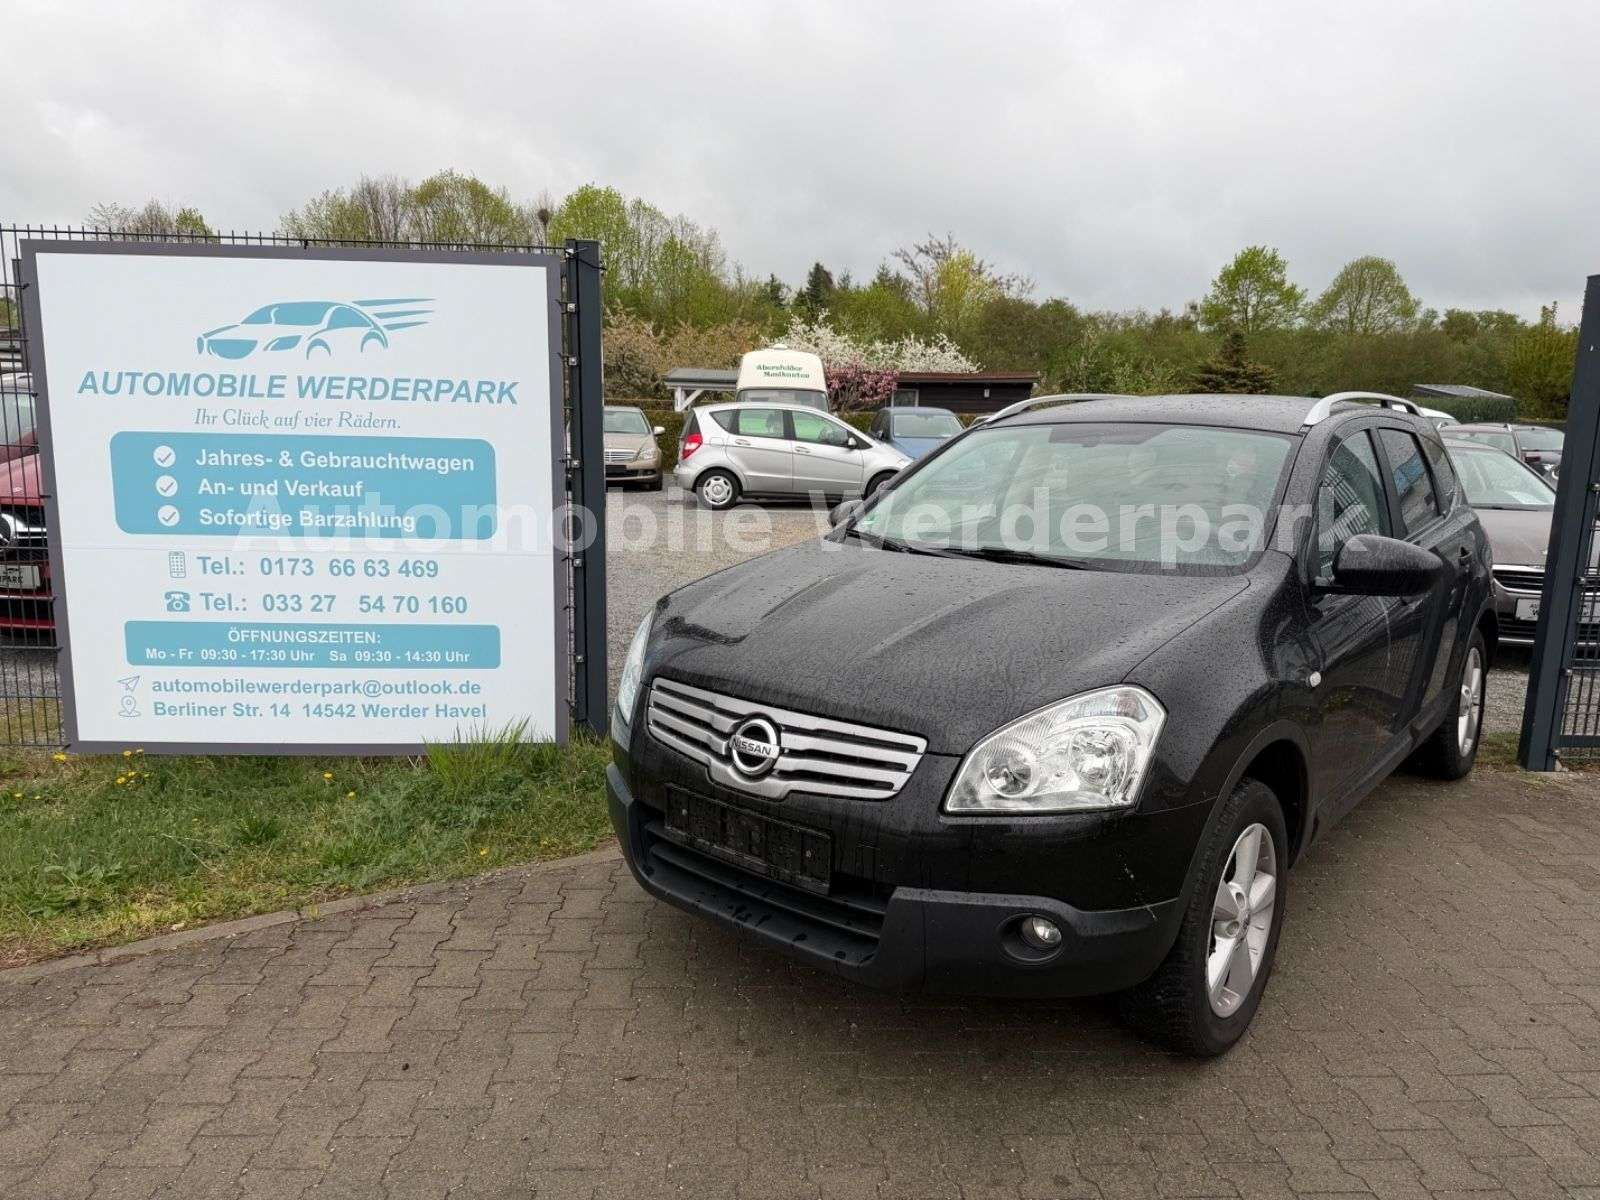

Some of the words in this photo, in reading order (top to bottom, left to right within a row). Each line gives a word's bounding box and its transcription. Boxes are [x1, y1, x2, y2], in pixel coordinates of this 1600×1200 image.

[78, 369, 286, 401] AUTOMOBILE
[296, 374, 520, 406] WERDERPARK
[194, 408, 217, 425] Ihr
[223, 408, 270, 429] Glück
[274, 410, 302, 430] auf
[304, 412, 333, 427] vier
[338, 411, 401, 429] Rädern.
[195, 449, 273, 467] Jahres-
[278, 450, 294, 467] &
[300, 451, 475, 475] Gebrauchtwagen
[198, 478, 234, 495] An-
[239, 479, 278, 496] und
[284, 480, 364, 498] Verkauf
[199, 508, 293, 531] Sofortige
[299, 510, 416, 533] Barzahlung
[197, 556, 246, 577] Tel.:
[260, 557, 315, 577] 0173
[328, 559, 357, 578] 66
[363, 559, 391, 578] 63
[398, 560, 440, 579] 469
[200, 593, 248, 613] Tel.:
[262, 594, 302, 613] 033
[309, 594, 337, 613] 27
[358, 595, 386, 614] 54
[392, 595, 420, 614] 70
[427, 596, 469, 615] 160
[228, 627, 382, 644] ÖFFNUNGSZEITEN:
[146, 648, 166, 659] Mo
[179, 648, 194, 660] Fr
[201, 649, 237, 660] 09:30
[251, 650, 286, 661] 17:30
[290, 650, 315, 661] Uhr
[329, 651, 347, 662] Sa
[355, 651, 392, 662] 09:30
[405, 651, 440, 662] 14:30
[445, 651, 471, 662] Uhr
[151, 679, 481, 698] automobilewerderpark@outlook.de
[154, 702, 227, 717] Berliner
[233, 703, 263, 717] Str.
[270, 703, 291, 718] 14
[303, 703, 356, 718] 14542
[361, 704, 429, 718] Werder
[435, 704, 486, 718] Havel
[732, 736, 772, 756] NISSAN
